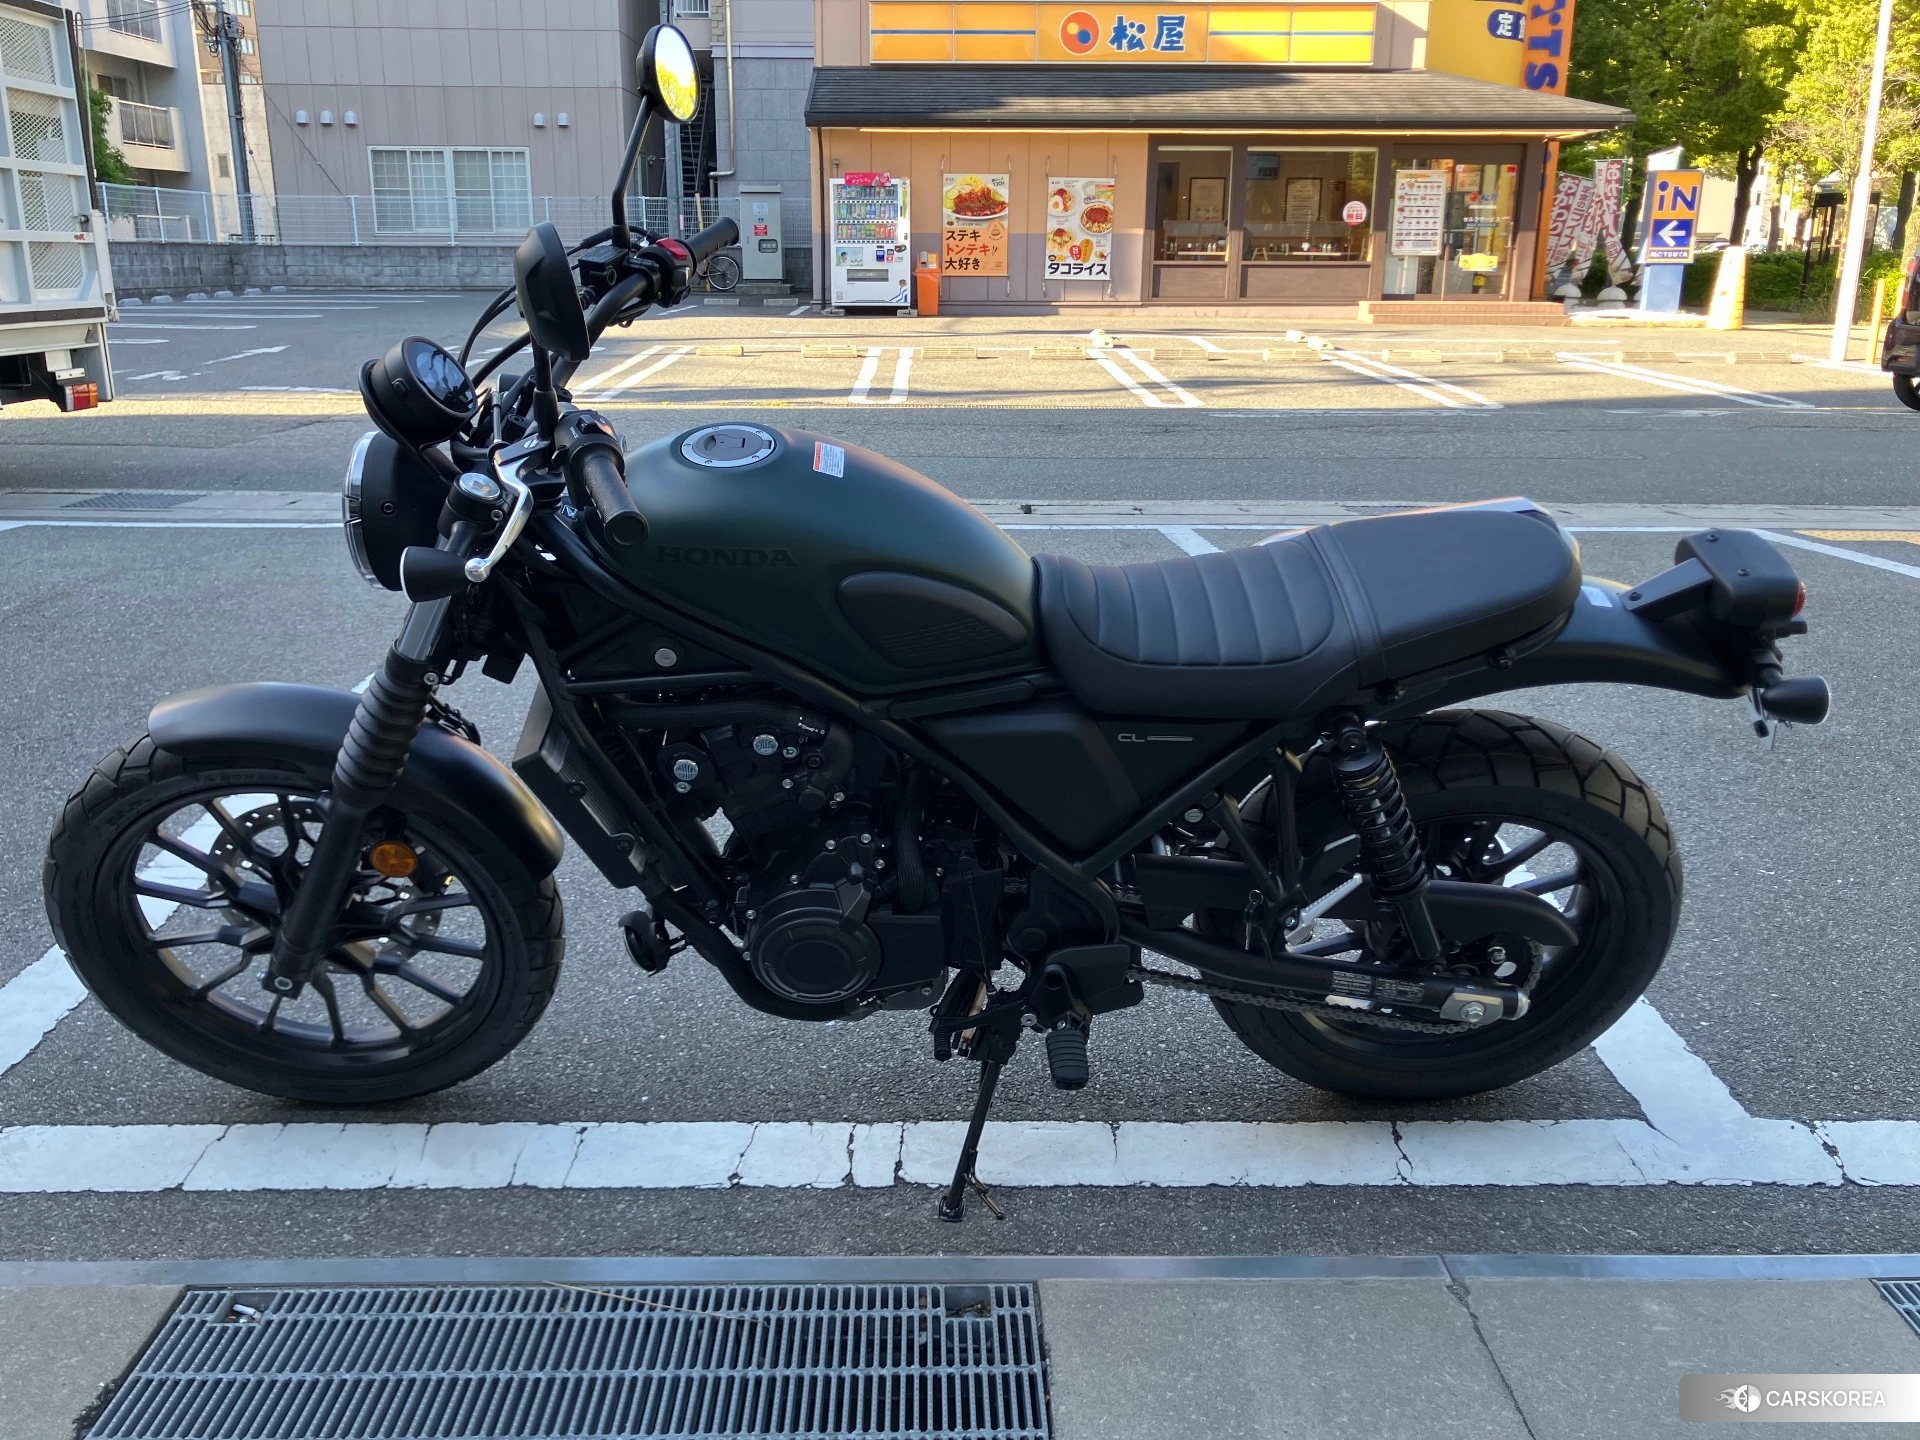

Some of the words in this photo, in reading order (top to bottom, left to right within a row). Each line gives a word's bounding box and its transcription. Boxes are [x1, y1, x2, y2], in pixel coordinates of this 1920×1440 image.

[1108, 14, 1186, 53] 松屋
[945, 229, 981, 242] ステキ
[945, 257, 981, 270] 大好き
[1047, 262, 1108, 275] タコライス
[654, 546, 797, 567] HONDA
[1117, 733, 1146, 743] CL
